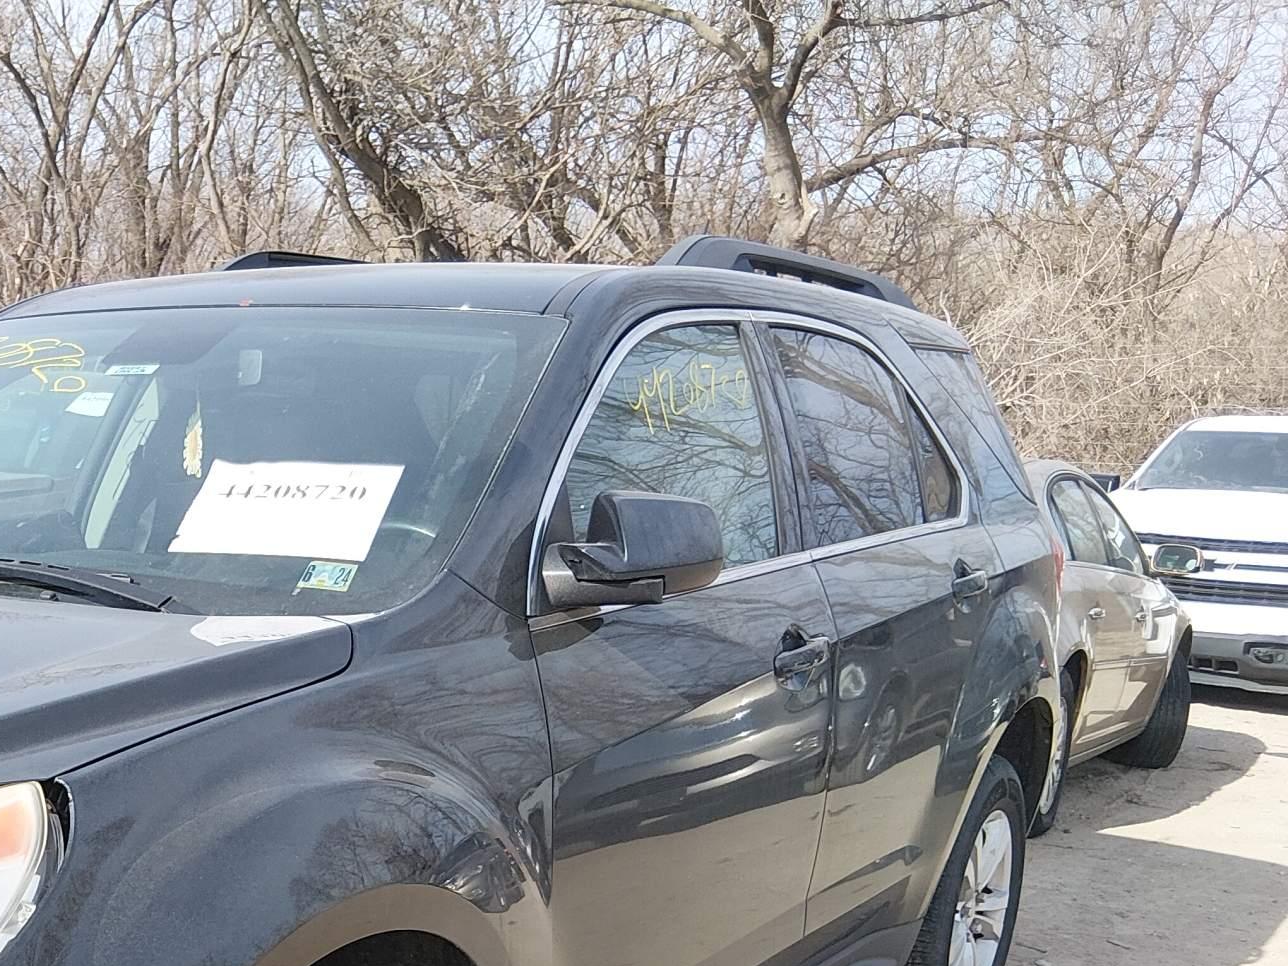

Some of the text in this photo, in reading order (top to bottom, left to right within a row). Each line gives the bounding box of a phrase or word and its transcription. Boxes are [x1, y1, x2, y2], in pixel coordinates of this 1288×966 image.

[217, 483, 368, 501] 44208720
[302, 564, 353, 586] 6 24
